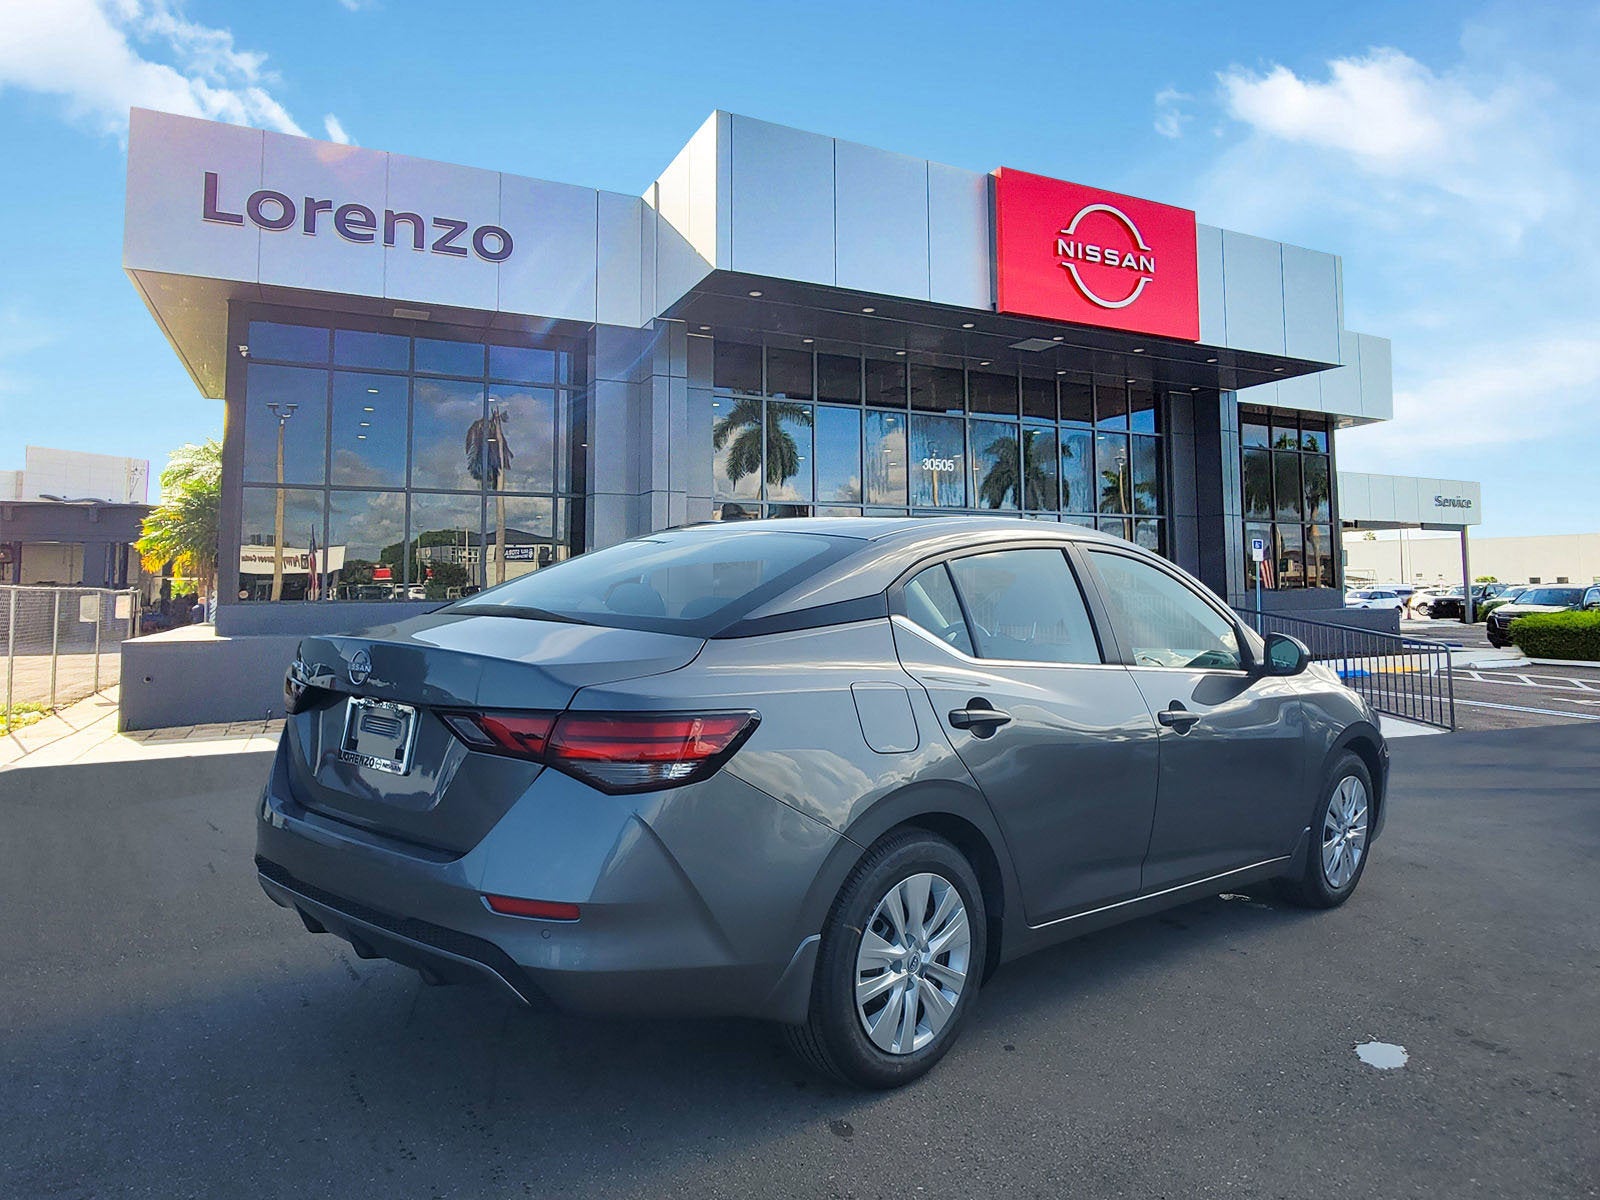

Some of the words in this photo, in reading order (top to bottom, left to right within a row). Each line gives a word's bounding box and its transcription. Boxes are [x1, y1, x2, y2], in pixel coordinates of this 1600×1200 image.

[202, 170, 515, 263] Lorenzo
[1056, 237, 1155, 274] NISSAN
[921, 457, 954, 473] 30505
[1434, 495, 1472, 509] Service
[347, 662, 372, 673] ISSAN
[338, 750, 375, 767] LORENZO
